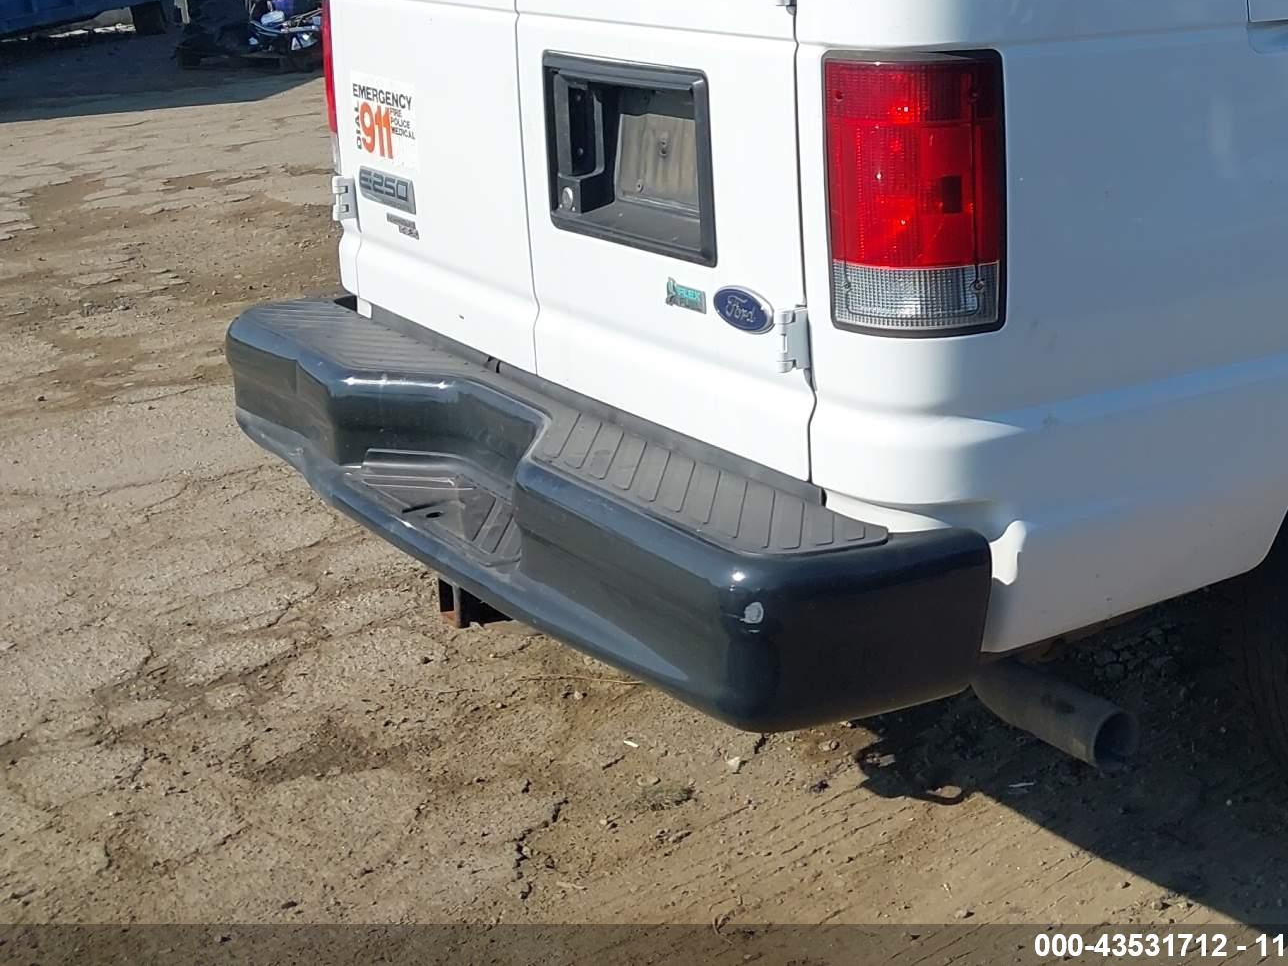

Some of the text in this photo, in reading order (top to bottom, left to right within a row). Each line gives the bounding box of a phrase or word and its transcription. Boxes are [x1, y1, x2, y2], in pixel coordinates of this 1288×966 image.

[352, 83, 412, 111] EMERGENCY
[360, 101, 394, 159] 911
[390, 126, 416, 141] MEDICAL
[725, 295, 756, 324] Ford
